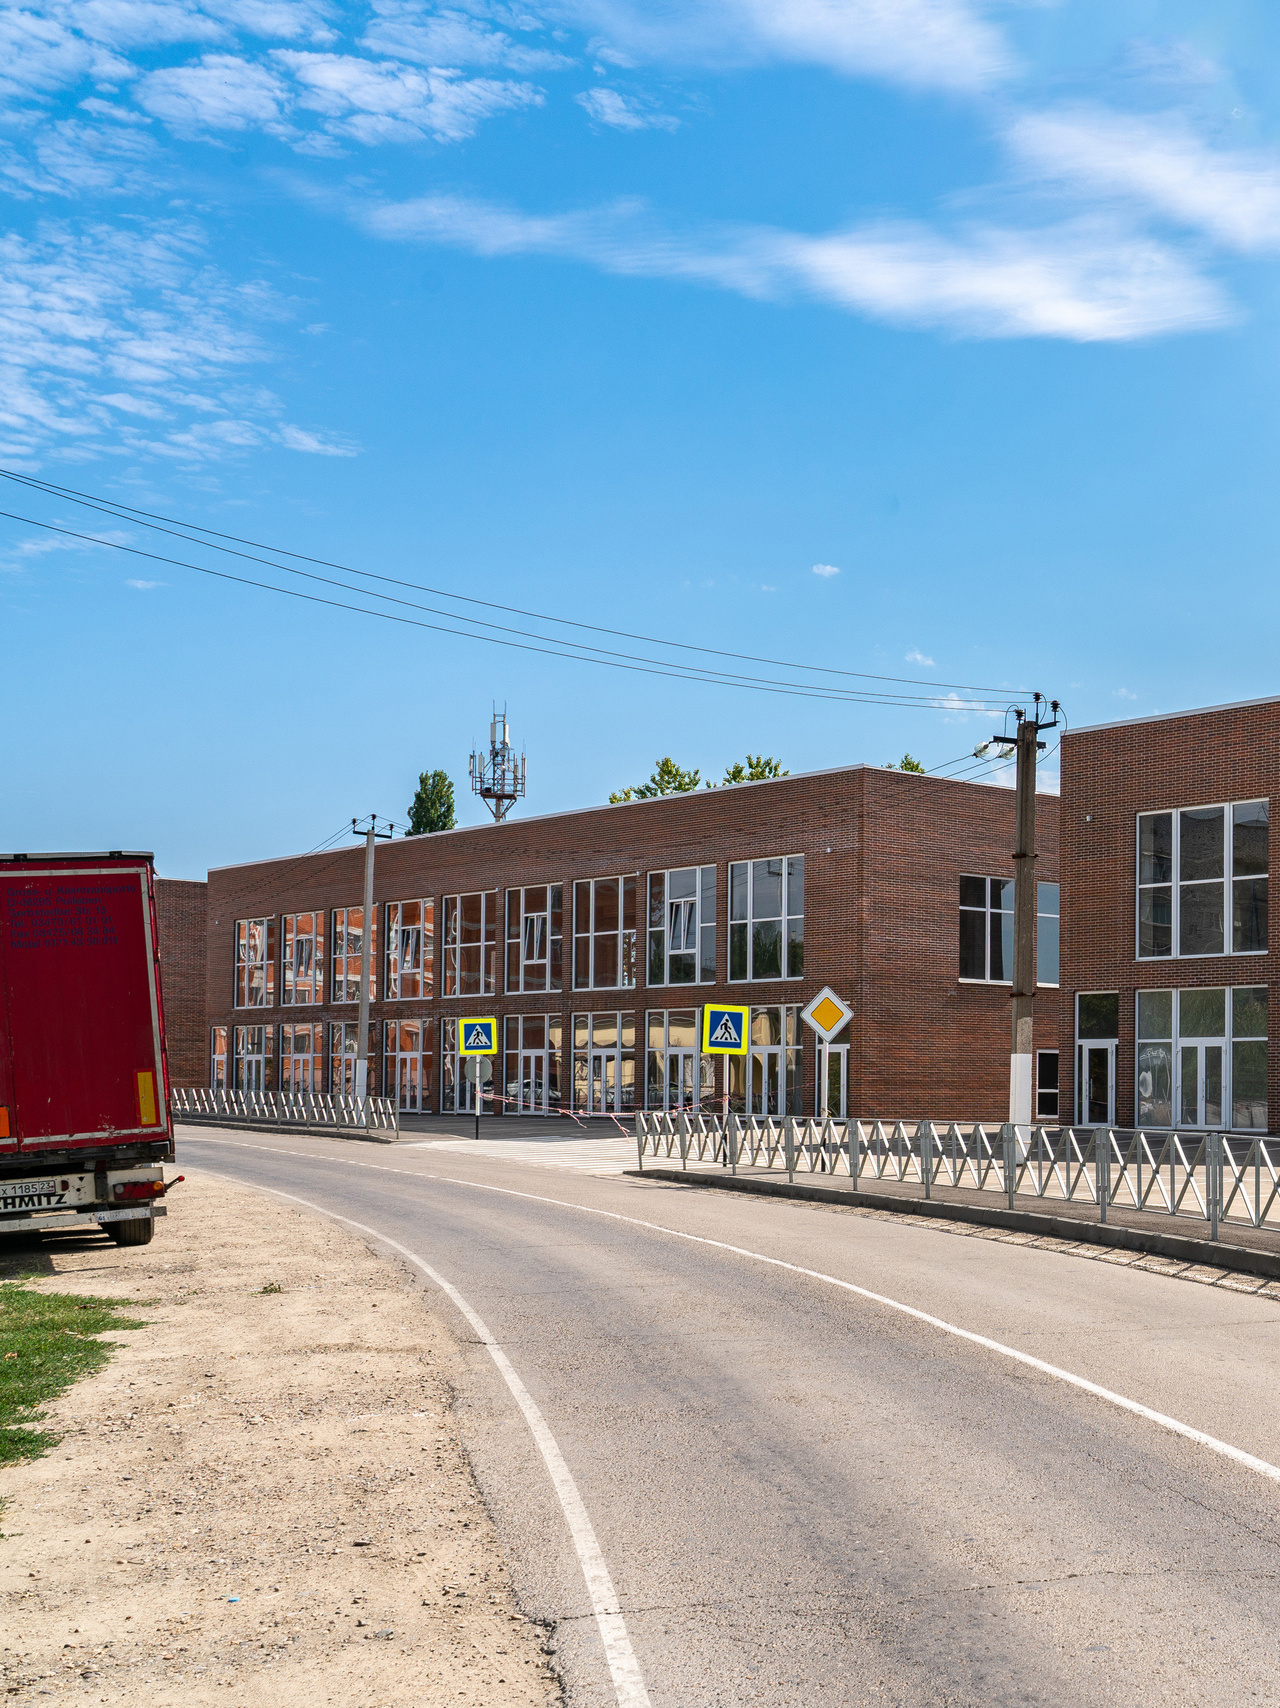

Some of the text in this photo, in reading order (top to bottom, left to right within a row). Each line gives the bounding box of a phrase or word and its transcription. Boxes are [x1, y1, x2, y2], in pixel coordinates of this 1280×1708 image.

[7, 885, 137, 897] Gross- u. Kleintransporte
[8, 896, 52, 907] D-06295
[75, 905, 91, 915] Str.
[95, 905, 108, 914] 15
[9, 918, 27, 928] Tel.
[86, 916, 97, 925] 01
[101, 915, 113, 925] 01
[10, 929, 30, 939] Fax
[87, 926, 99, 936] 34
[102, 925, 115, 935] 84
[11, 939, 41, 949] Mobil
[11, 1183, 38, 1195] 1185
[40, 1182, 51, 1190] 23
